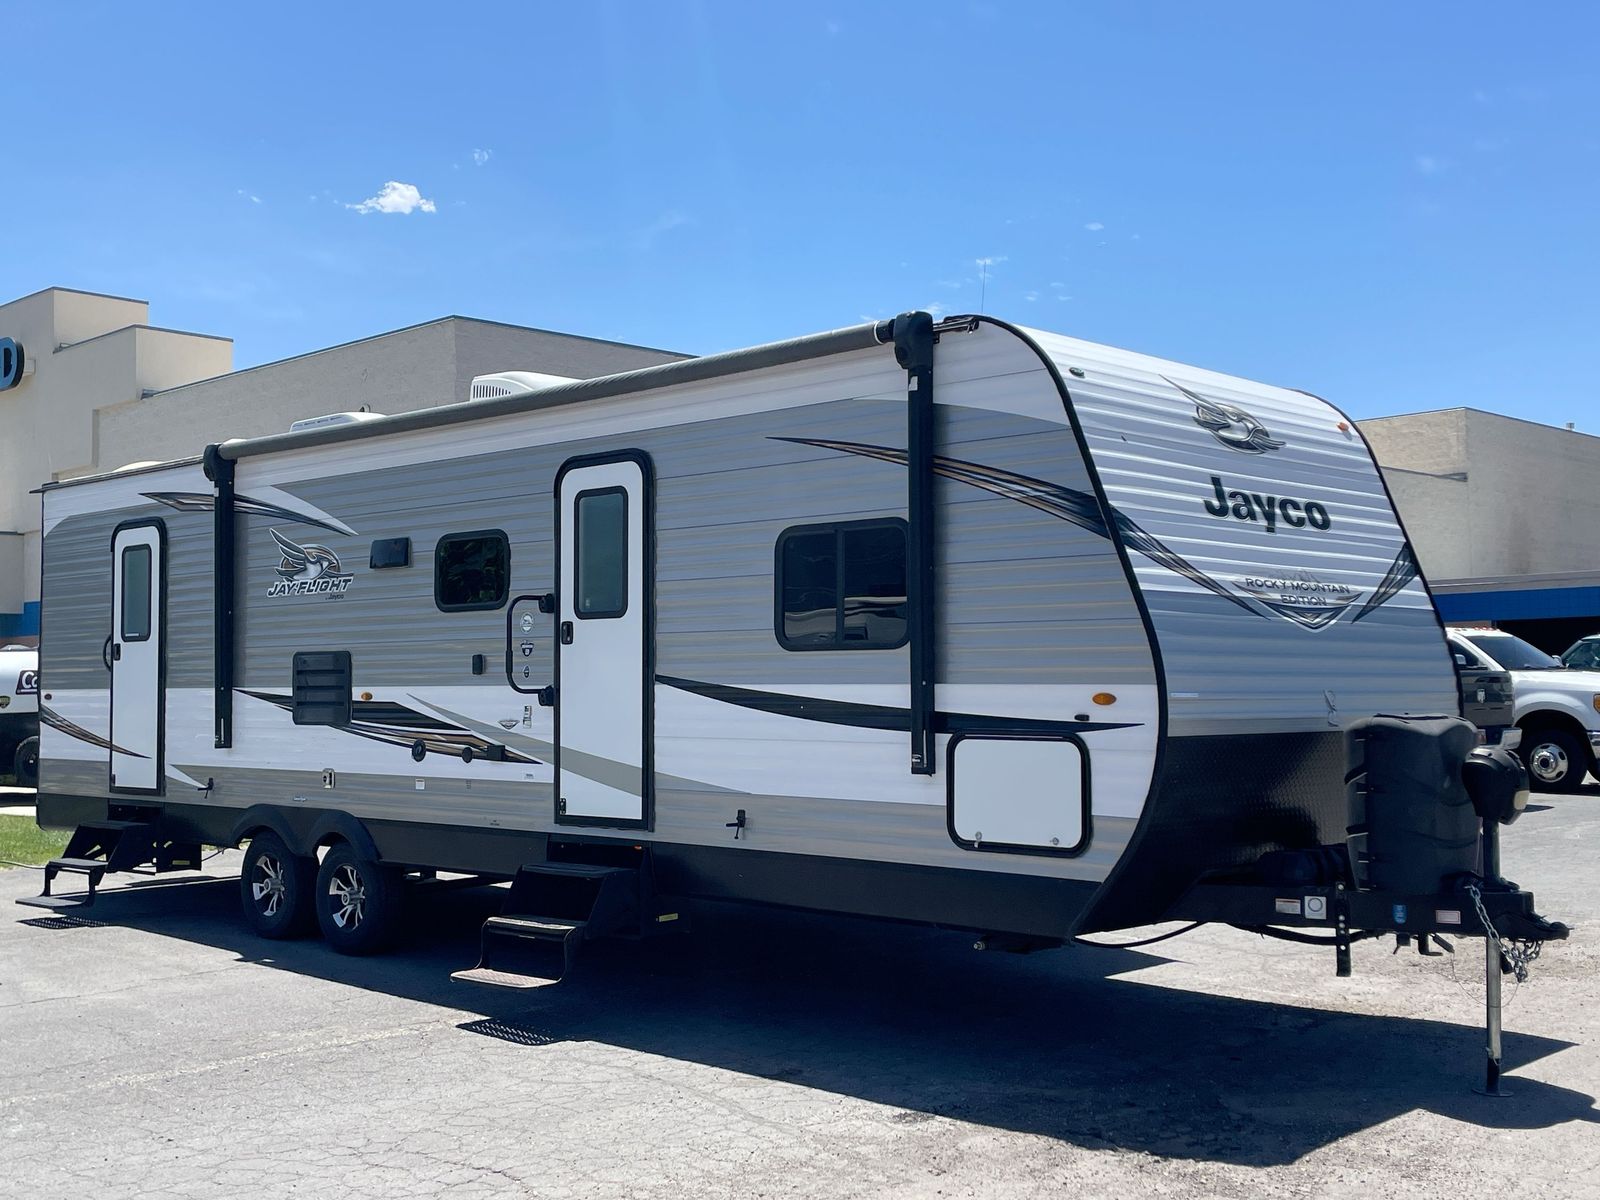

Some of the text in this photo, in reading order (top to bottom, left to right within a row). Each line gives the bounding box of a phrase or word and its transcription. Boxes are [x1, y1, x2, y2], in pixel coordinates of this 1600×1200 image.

[1203, 475, 1331, 533] Jayco
[267, 577, 353, 597] JAY FLIGHT
[1245, 578, 1351, 594] ROCKY MOUNTAIN
[1280, 594, 1328, 606] EDITION
